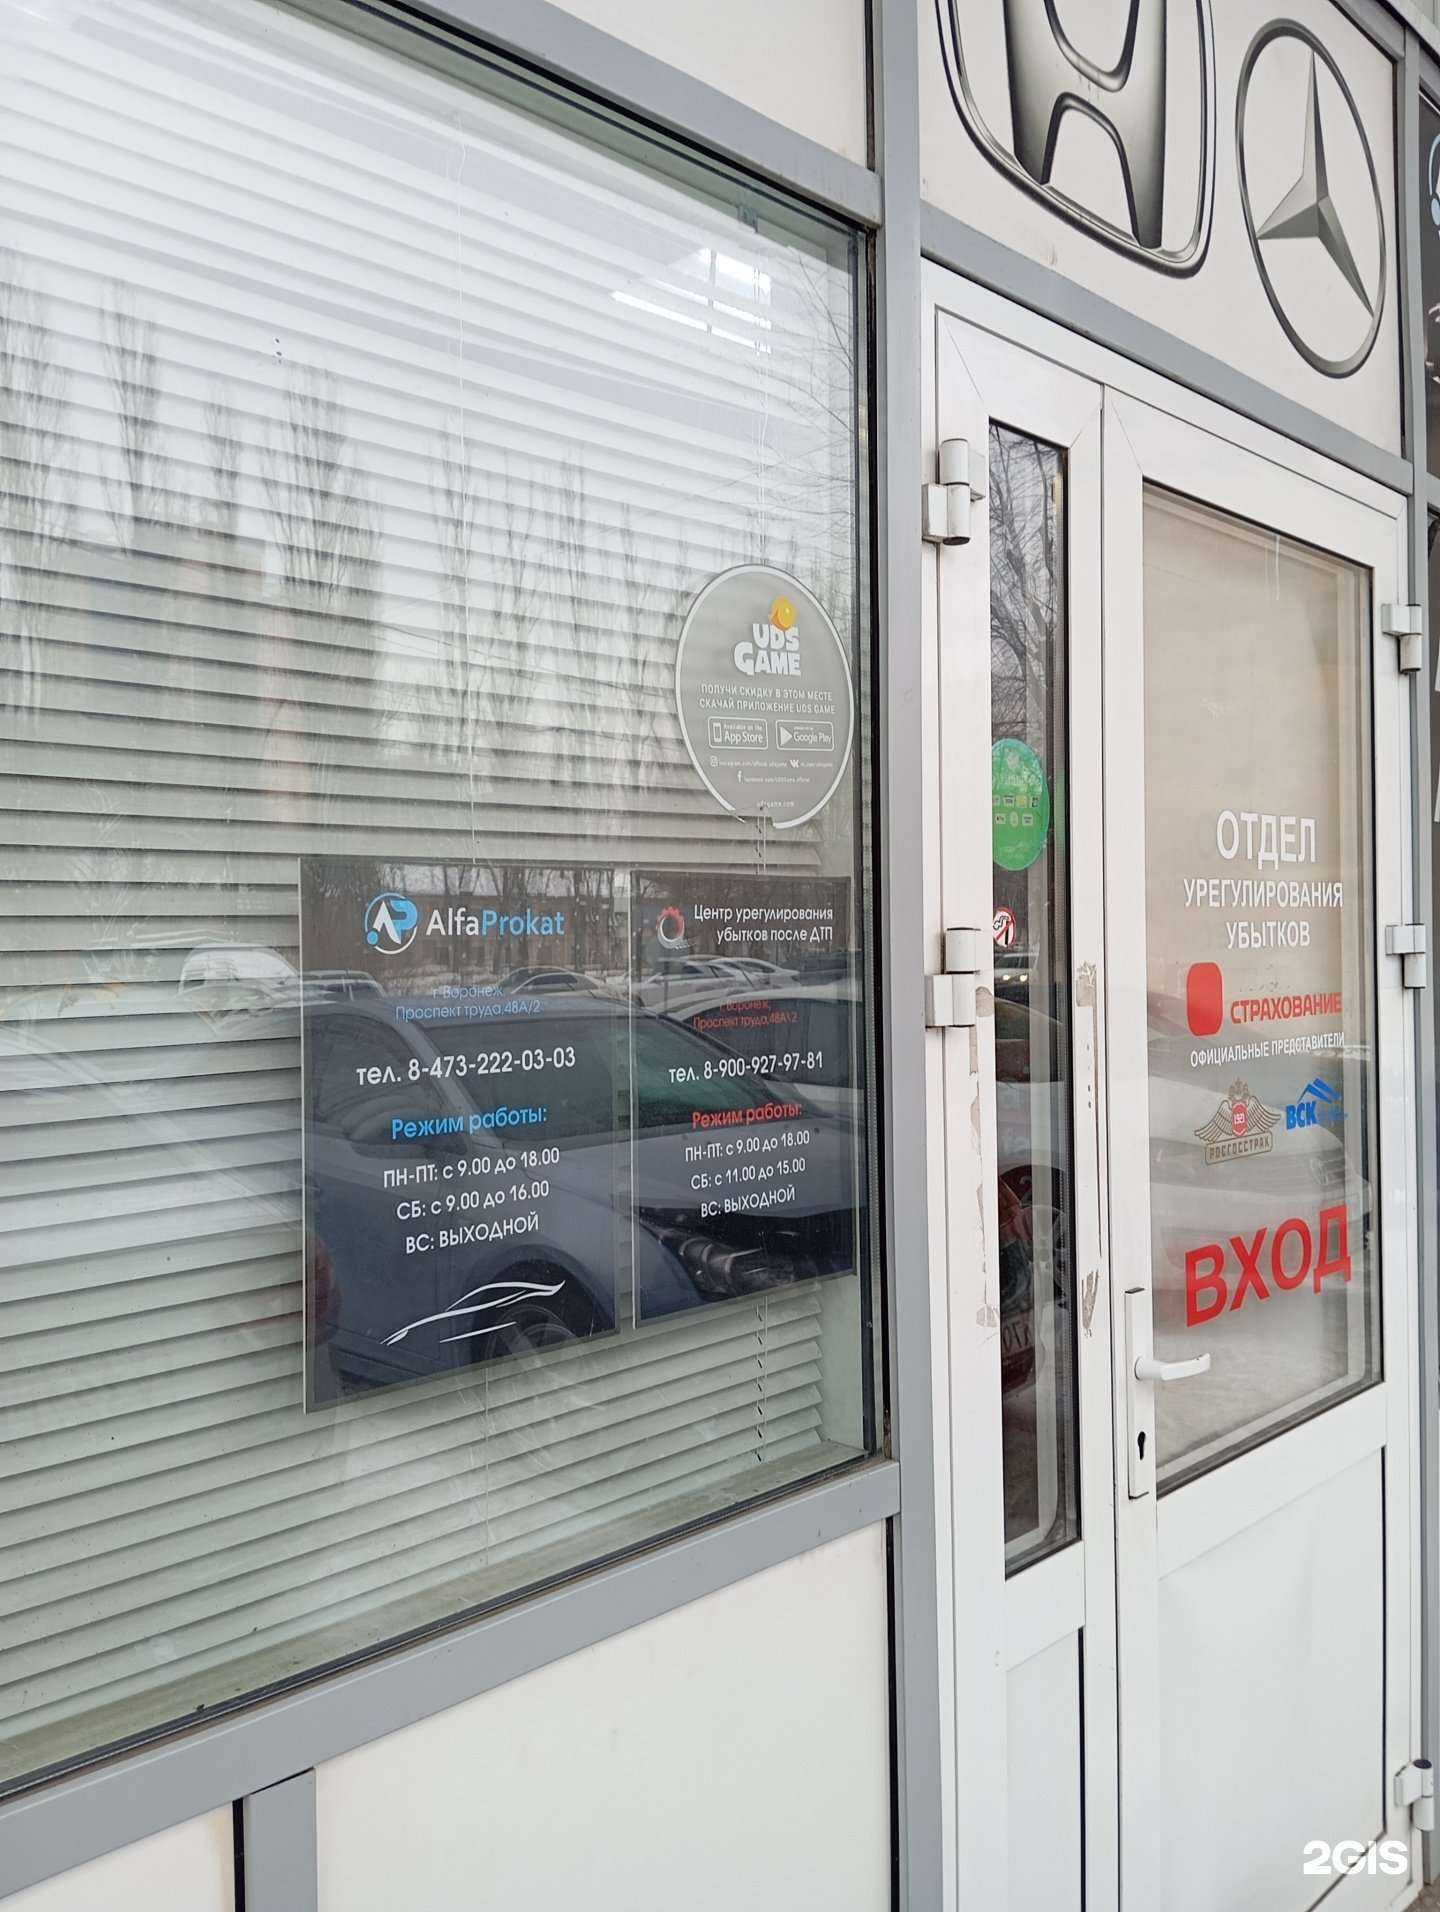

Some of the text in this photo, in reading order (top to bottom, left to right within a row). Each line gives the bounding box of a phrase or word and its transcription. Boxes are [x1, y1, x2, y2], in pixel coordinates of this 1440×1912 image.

[753, 623, 799, 652] UDS
[734, 641, 801, 676] GAME
[700, 698, 734, 709] СКАЧАЙ
[737, 700, 794, 713] ПРИЛОЖЕНИЕ
[796, 703, 812, 713] UDS
[701, 683, 832, 701] ПОЛУЧИ СКИДКУ В ЭТОМ МЕСТЕ
[724, 730, 763, 745] App Store
[793, 731, 832, 744] Google Play
[1216, 809, 1317, 871] ОТДЕЛ
[1183, 878, 1344, 909] УРЕГУЛИРОВАНИЯ
[425, 907, 565, 937] AlfaProkat
[694, 904, 833, 923] Центр урегулирования
[716, 926, 833, 944] убытков после ДТП
[1226, 920, 1311, 950] УБЫТКОВ
[395, 1005, 461, 1024] Проспект
[1230, 991, 1343, 1025] СТРАХОВАНИЕ
[693, 1015, 738, 1033] Проспект
[1190, 1031, 1345, 1069] ОФИЦИАЛЬНЫЕ ПРЕДСТАВИТЕЛИ
[356, 1046, 576, 1086] тел. 8-473-222-03-03
[668, 1050, 824, 1083] тел. 8-900-927-97-81
[391, 1106, 548, 1140] Режим работы:
[691, 1102, 803, 1130] Режим работы:
[1286, 1100, 1318, 1131] ВСК
[685, 1129, 810, 1163] ПН-ПТ: с 9.00 до 18.00
[1209, 1135, 1270, 1160] РОСГОССТРАХ
[383, 1147, 560, 1188] ПН-ПТ: с 9.00 до 18.00
[690, 1157, 807, 1190] СБ: с 11.00 до 15.00
[396, 1180, 550, 1221] СБ: с 9.00 до 16.00
[701, 1184, 796, 1218] ВС: ВЫХОДНОЙ
[405, 1210, 540, 1254] ВС: ВЫХОДНОЙ
[1184, 1203, 1353, 1328] ВХОД
